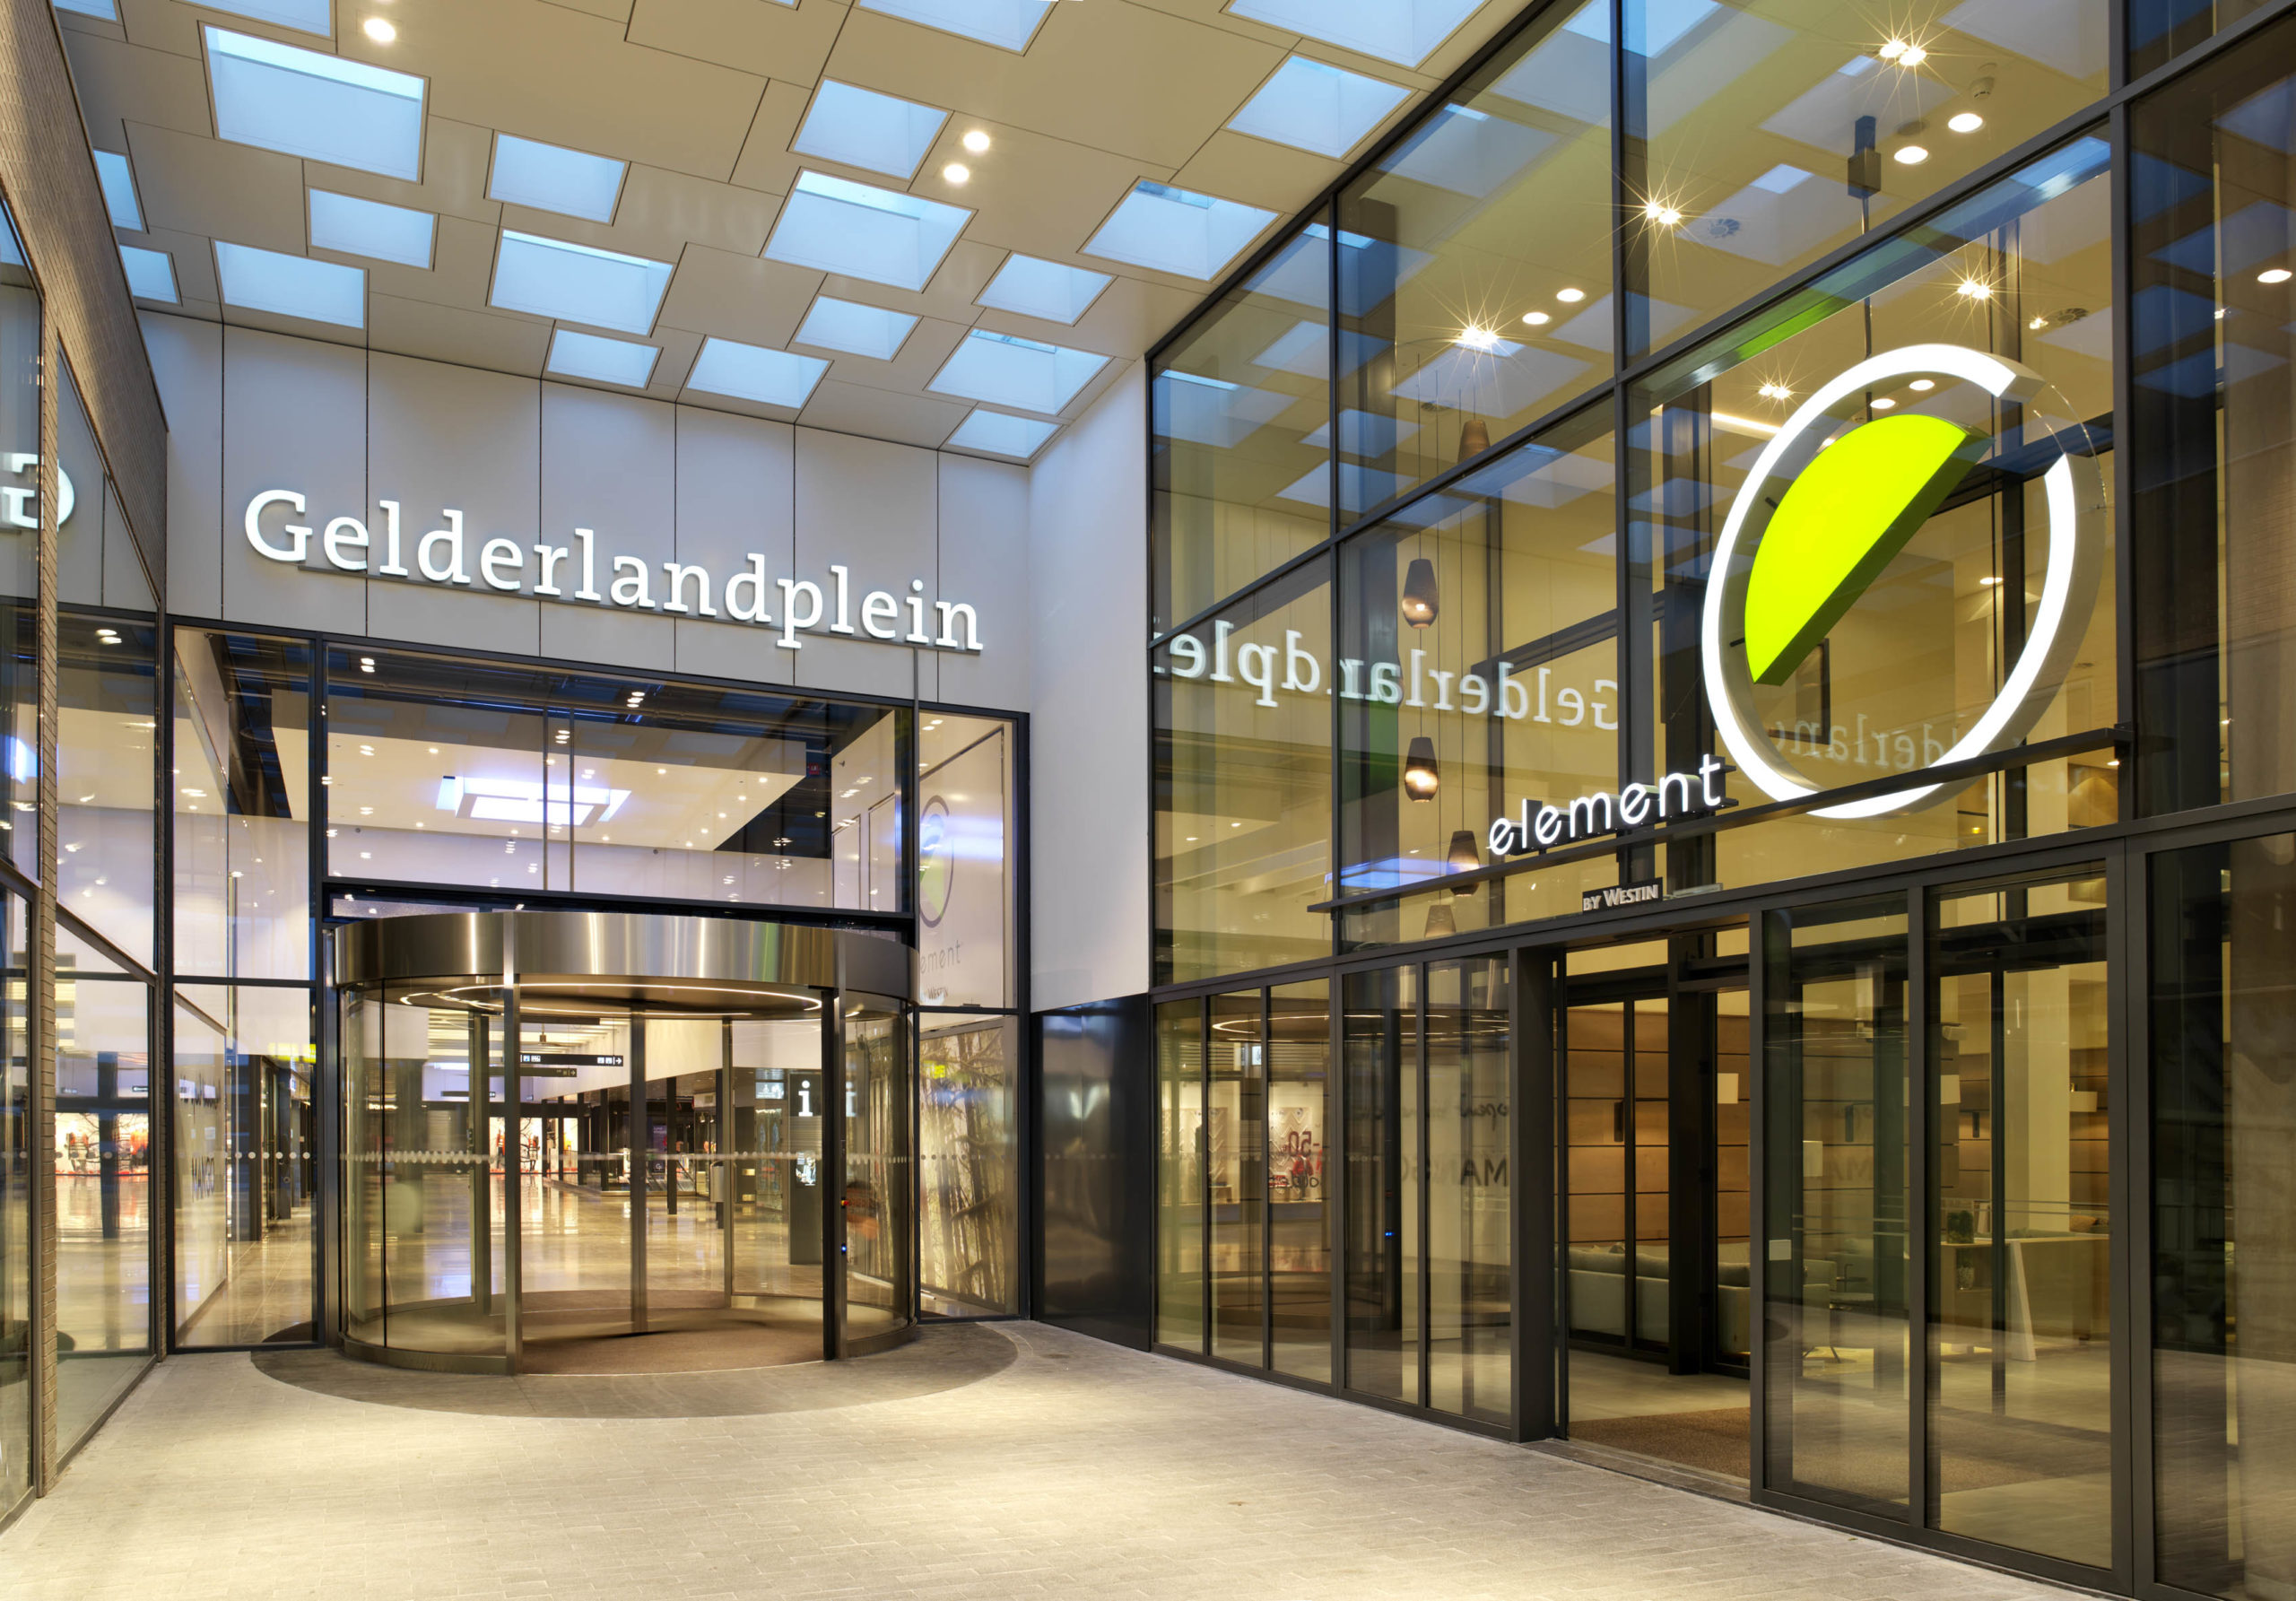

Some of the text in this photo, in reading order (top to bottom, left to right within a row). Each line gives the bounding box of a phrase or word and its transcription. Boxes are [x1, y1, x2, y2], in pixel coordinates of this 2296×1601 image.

[244, 489, 985, 651] Gelderlandplein
[1487, 753, 1720, 856] element
[1583, 895, 1602, 911] BY
